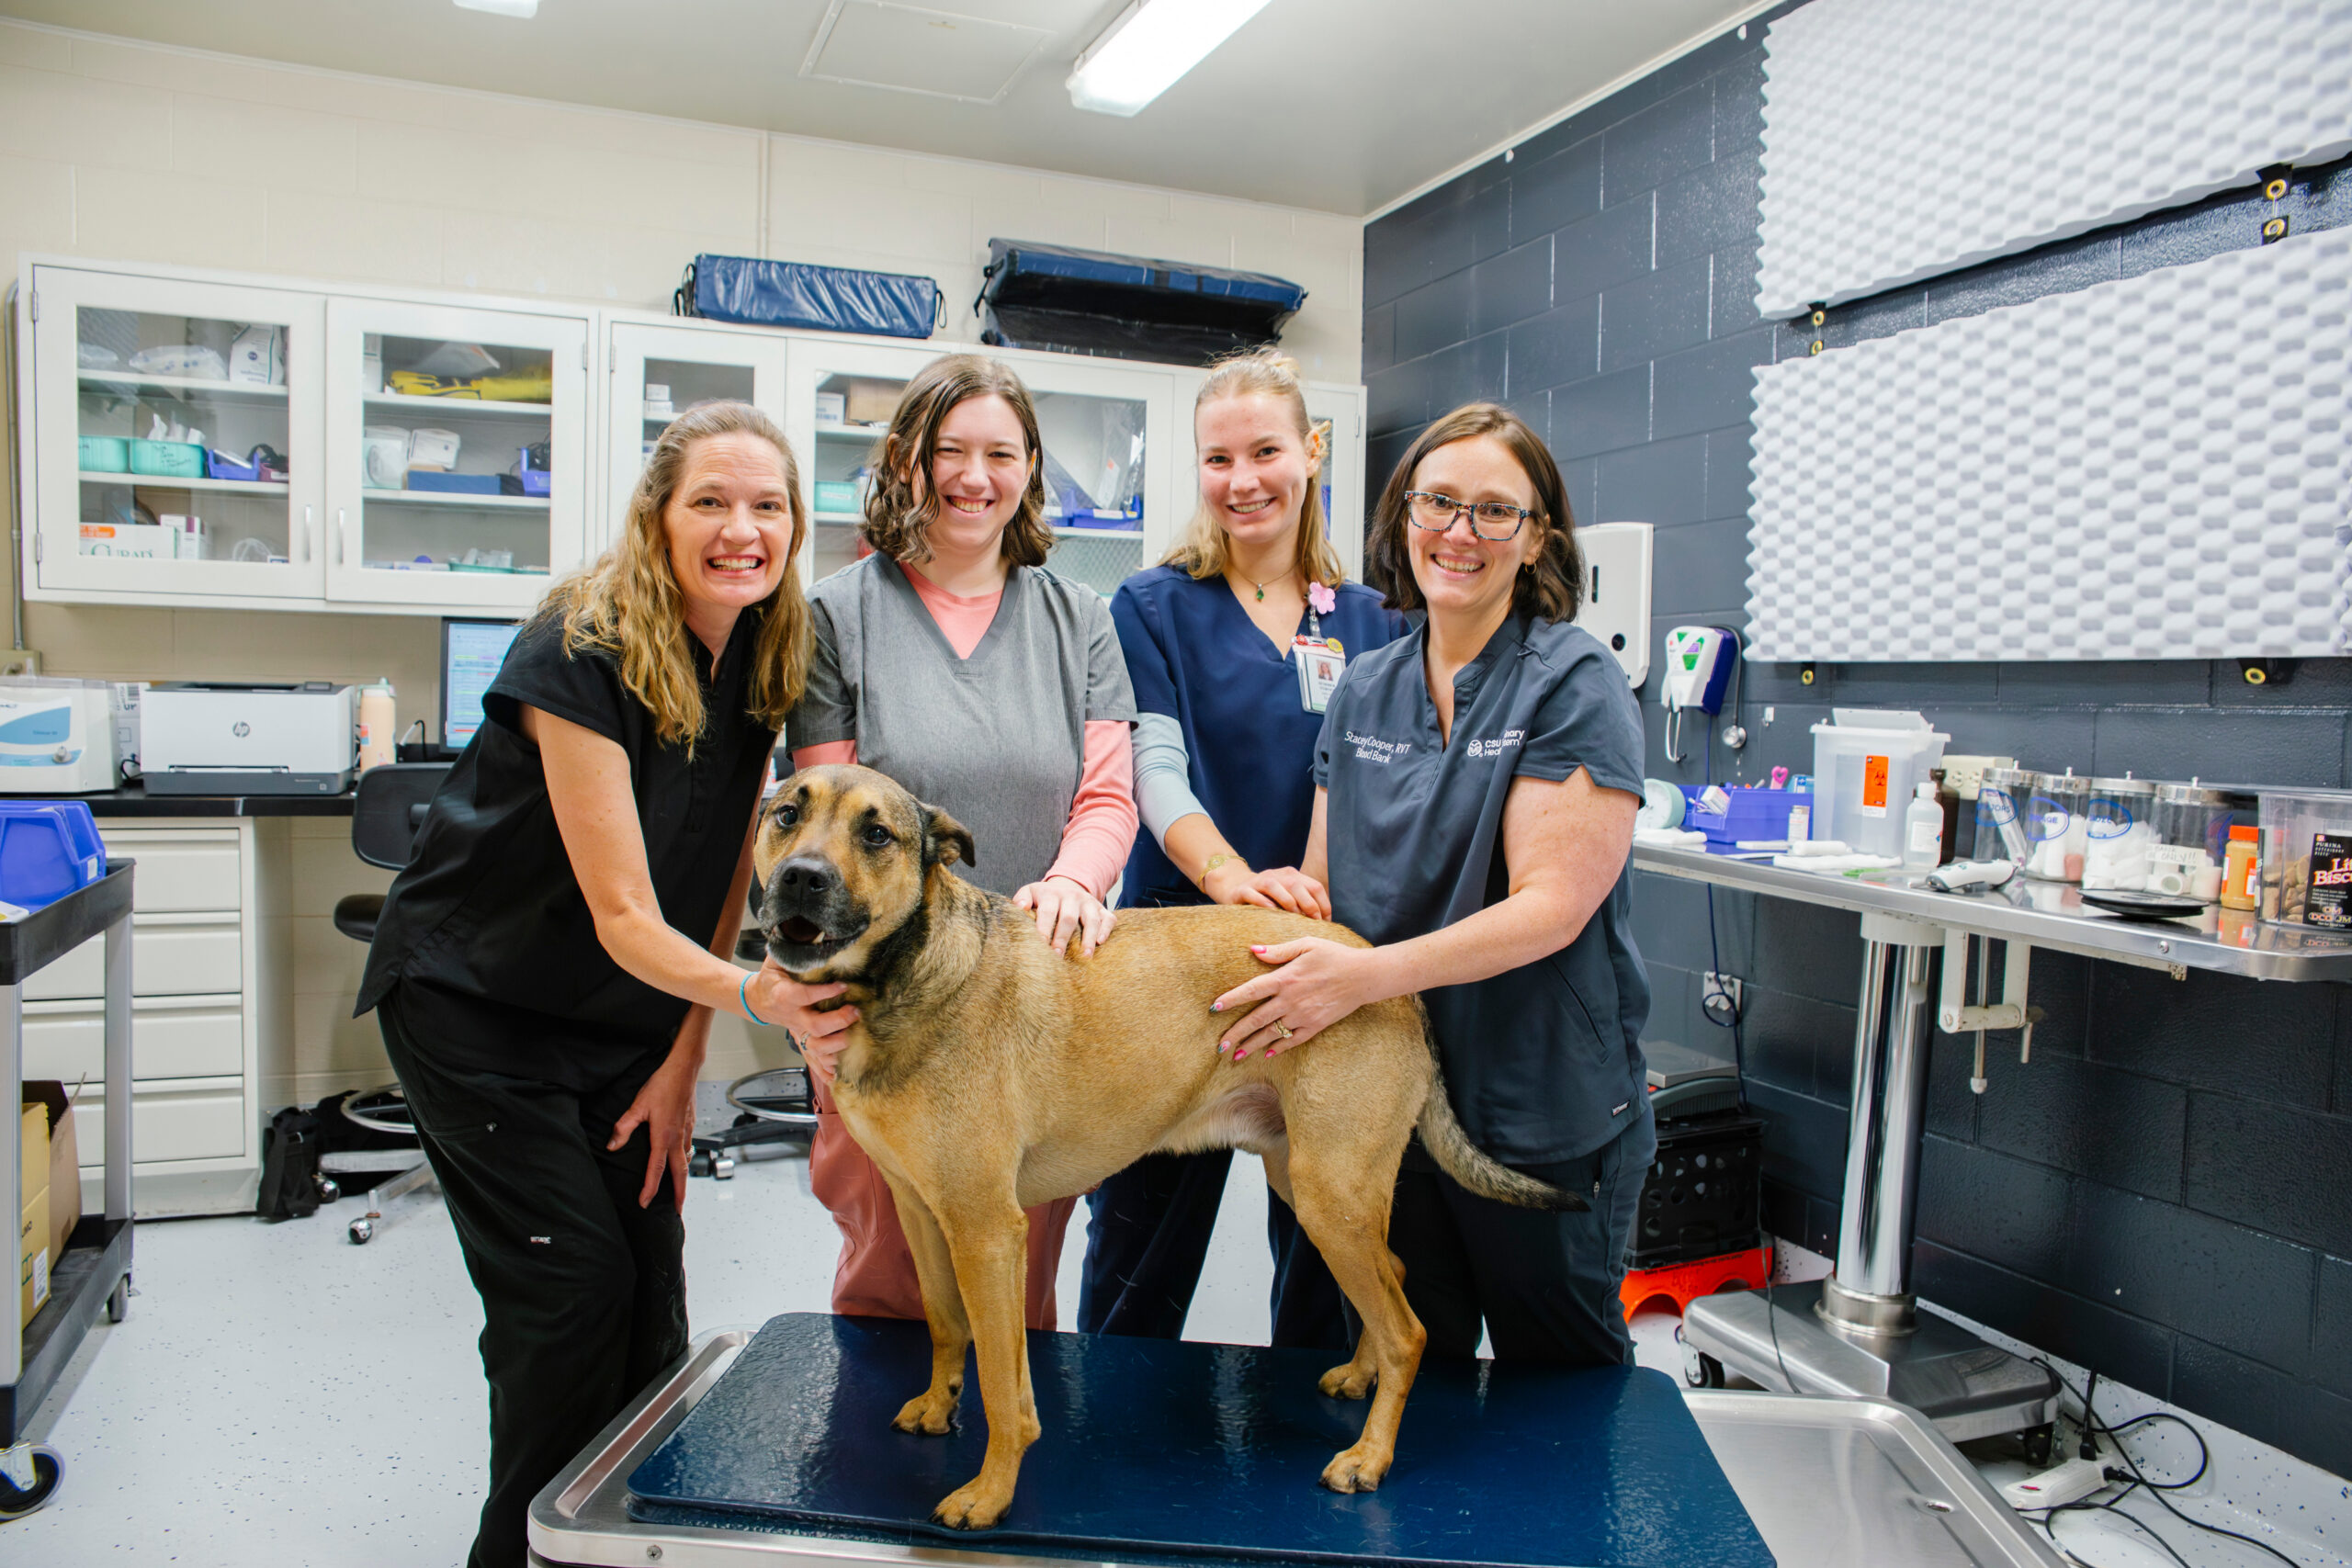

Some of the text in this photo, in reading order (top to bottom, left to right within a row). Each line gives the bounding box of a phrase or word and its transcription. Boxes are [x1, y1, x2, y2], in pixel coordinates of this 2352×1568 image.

[1344, 730, 1367, 748] Stacey
[1485, 739, 1502, 748] CSU
[1355, 747, 1393, 764] Blood Bank
[1484, 747, 1502, 757] Heal
